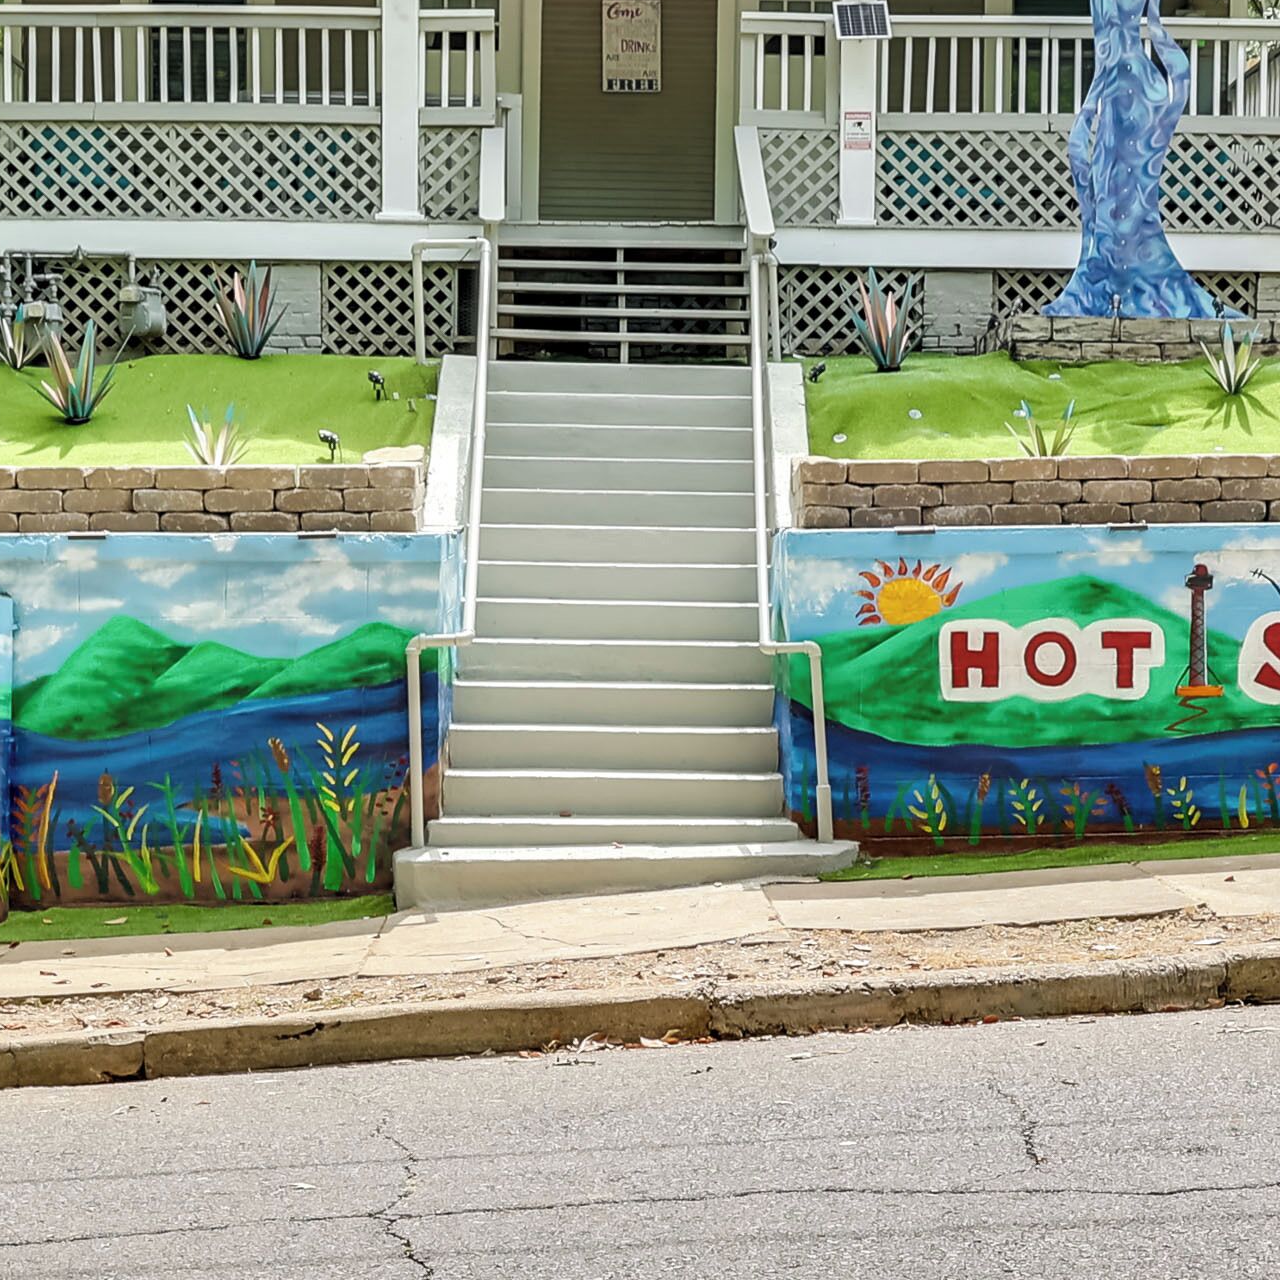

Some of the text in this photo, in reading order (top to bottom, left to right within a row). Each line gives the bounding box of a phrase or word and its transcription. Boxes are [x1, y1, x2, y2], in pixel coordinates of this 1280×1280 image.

[607, 1, 642, 21] Come
[607, 78, 658, 90] FREE
[950, 630, 1152, 689] HOT
